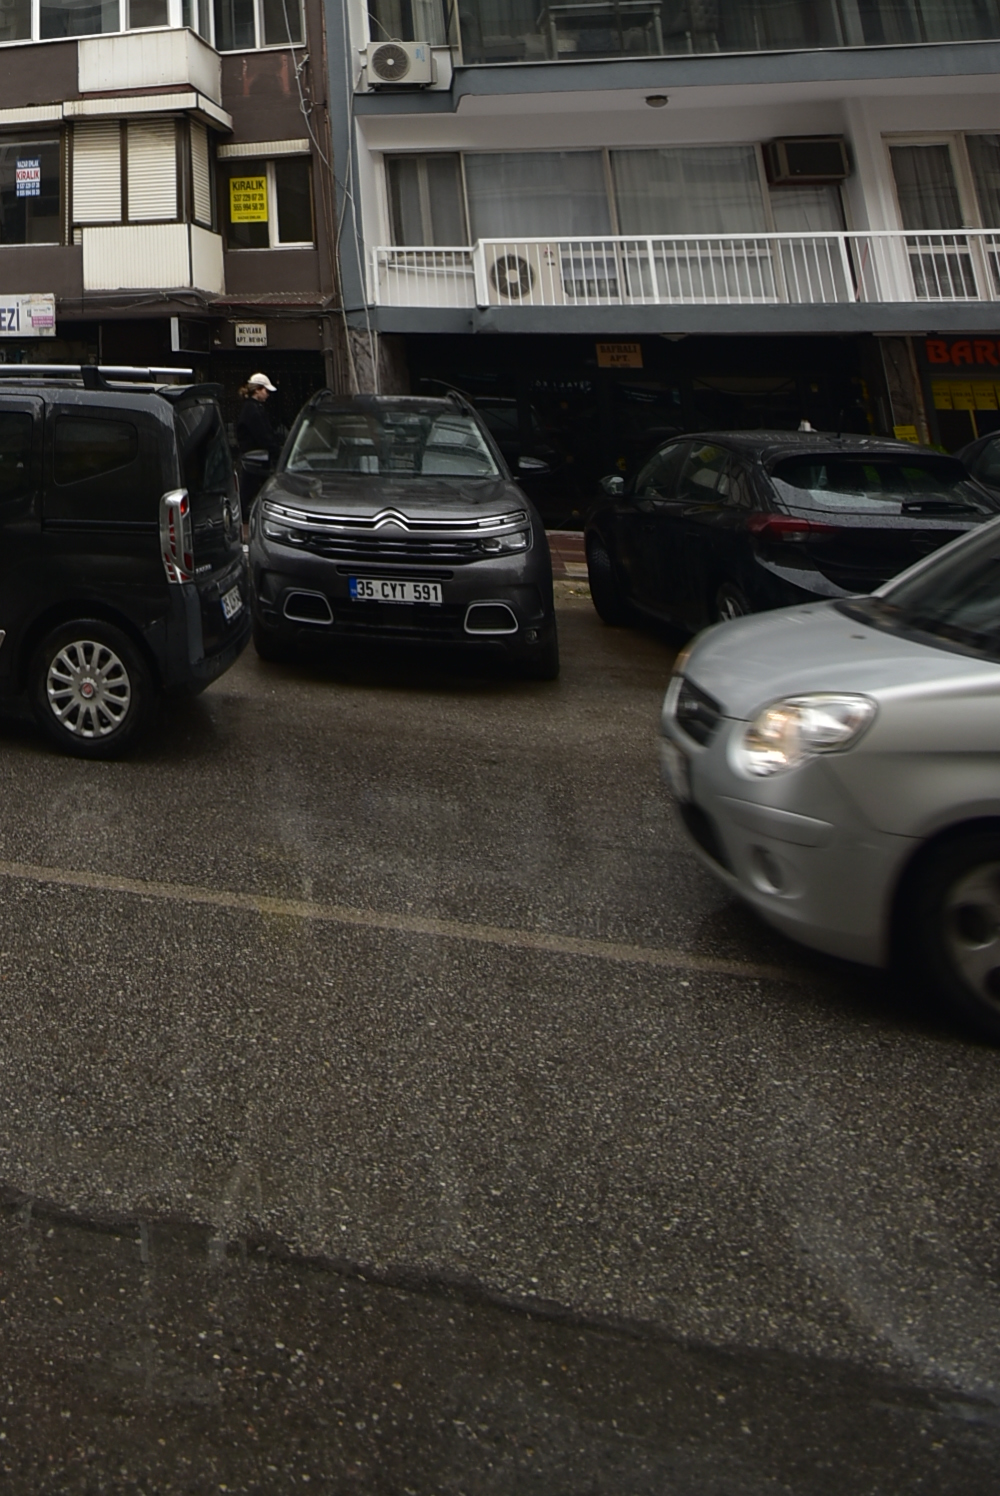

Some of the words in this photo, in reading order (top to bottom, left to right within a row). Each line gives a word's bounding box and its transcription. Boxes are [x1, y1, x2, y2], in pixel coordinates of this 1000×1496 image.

[926, 339, 1000, 366] BAR
[358, 581, 374, 597] 35
[381, 582, 406, 599] CYT
[413, 584, 438, 601] 591
